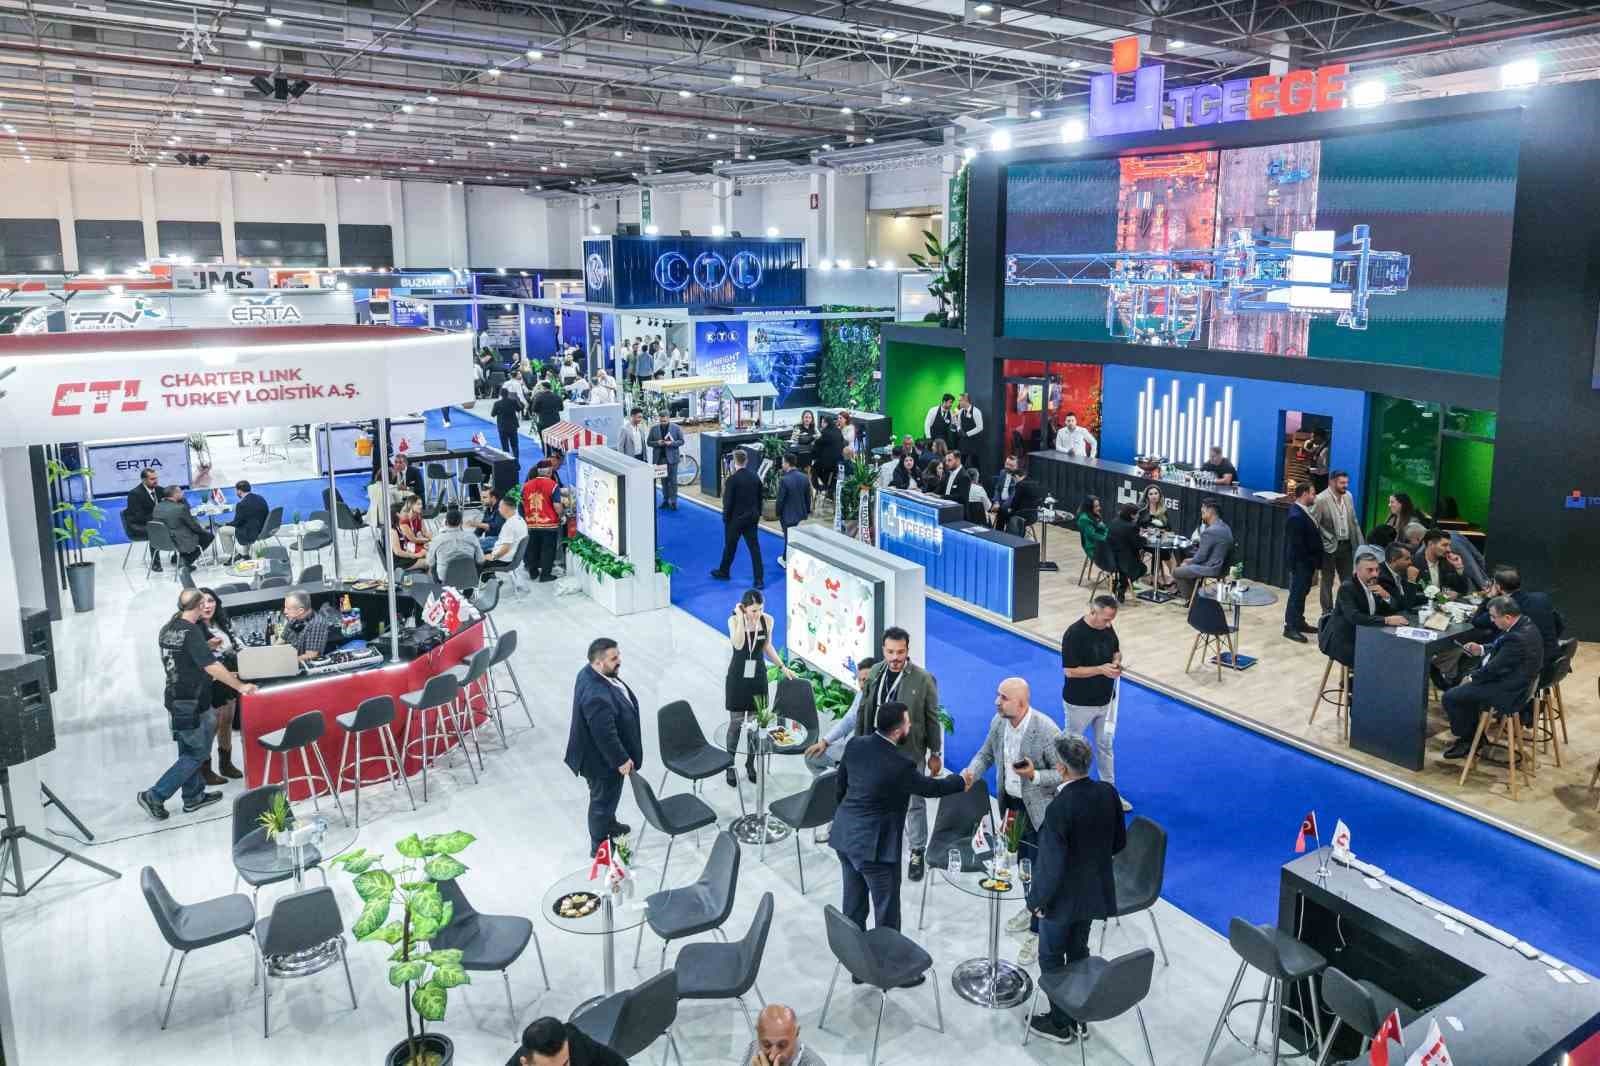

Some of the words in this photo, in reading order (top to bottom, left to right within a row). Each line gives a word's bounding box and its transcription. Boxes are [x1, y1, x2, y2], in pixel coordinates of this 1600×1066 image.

[1169, 64, 1346, 128] TCEEGE
[654, 251, 763, 292] CTL
[231, 306, 301, 321] ERTA
[52, 380, 148, 416] CTL
[161, 371, 254, 388] CHARTER
[259, 368, 303, 384] LINK
[162, 390, 241, 408] TURKEY
[246, 383, 324, 404] LOJİSTİK
[328, 383, 360, 399] A.Ş.
[116, 458, 163, 471] ERTA
